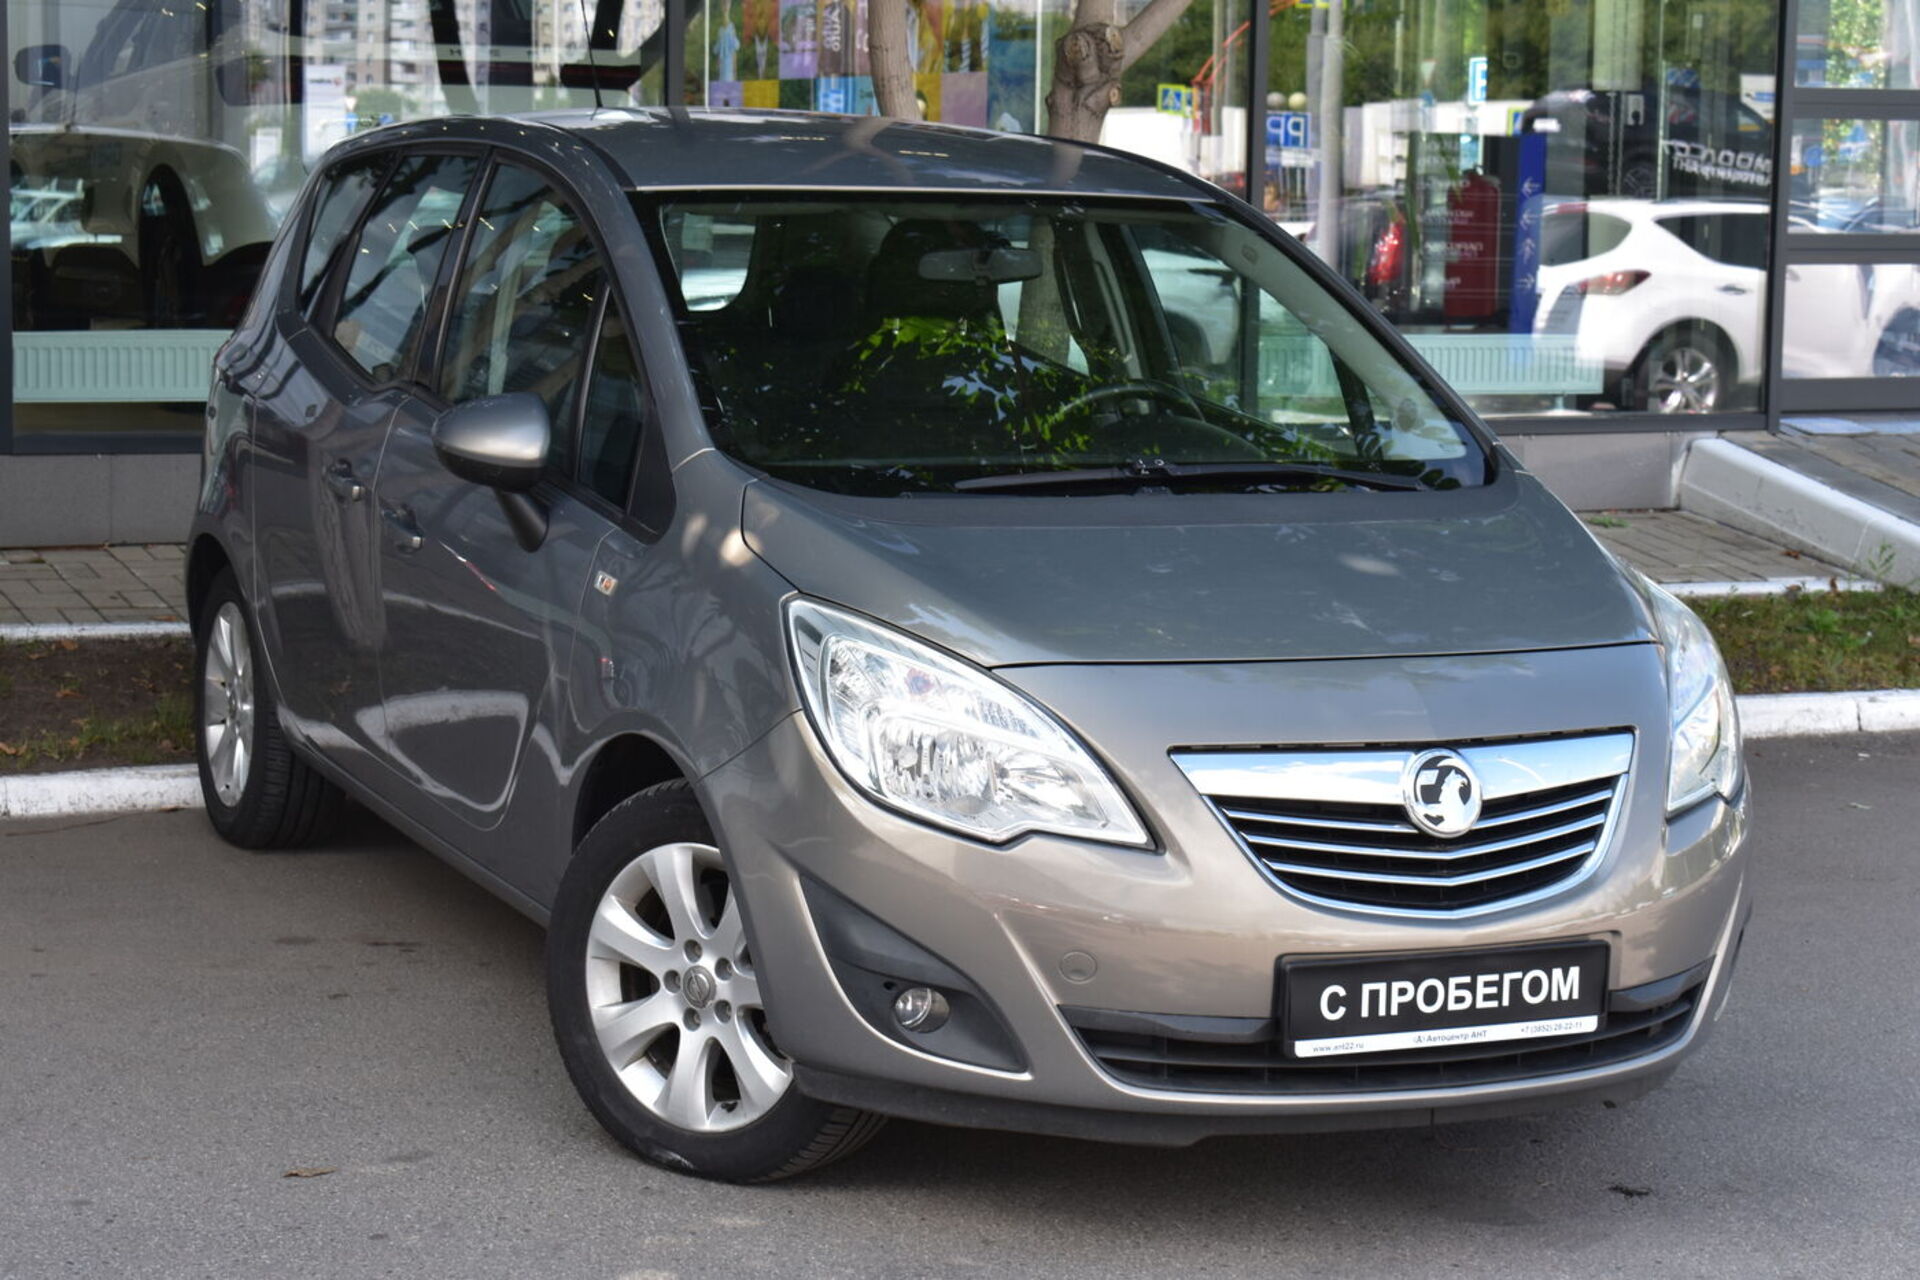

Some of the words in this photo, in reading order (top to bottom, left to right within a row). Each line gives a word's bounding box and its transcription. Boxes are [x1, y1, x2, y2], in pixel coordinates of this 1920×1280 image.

[1320, 985, 1347, 1021] С
[1360, 966, 1581, 1018] ПРОБЕГОМ
[1426, 1033, 1469, 1042] Автоцентр
[1471, 1030, 1487, 1039] АНТ
